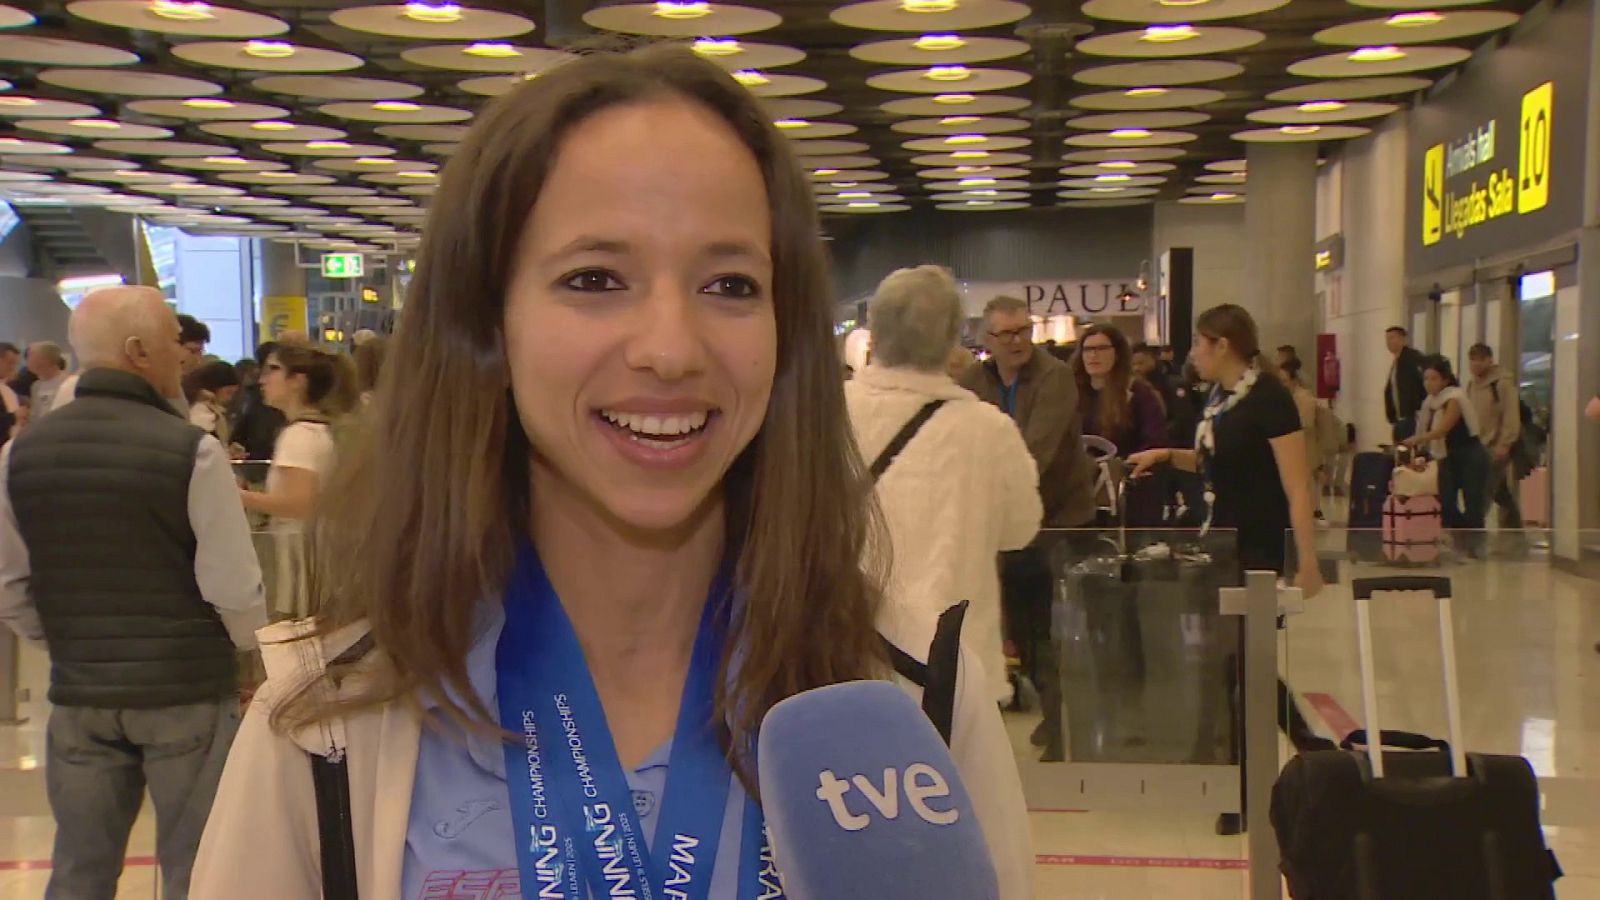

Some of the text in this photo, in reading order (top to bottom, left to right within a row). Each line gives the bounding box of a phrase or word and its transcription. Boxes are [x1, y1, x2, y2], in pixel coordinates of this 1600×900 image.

[1476, 119, 1496, 164] hall
[1522, 109, 1547, 191] 10
[1445, 168, 1514, 239] Llegadas Sala
[1023, 284, 1139, 313] PAUL
[522, 709, 548, 819] CHAMPIONSHIPS
[554, 693, 638, 900] NNING CHAMPIONSHIPS
[816, 762, 960, 831] tve
